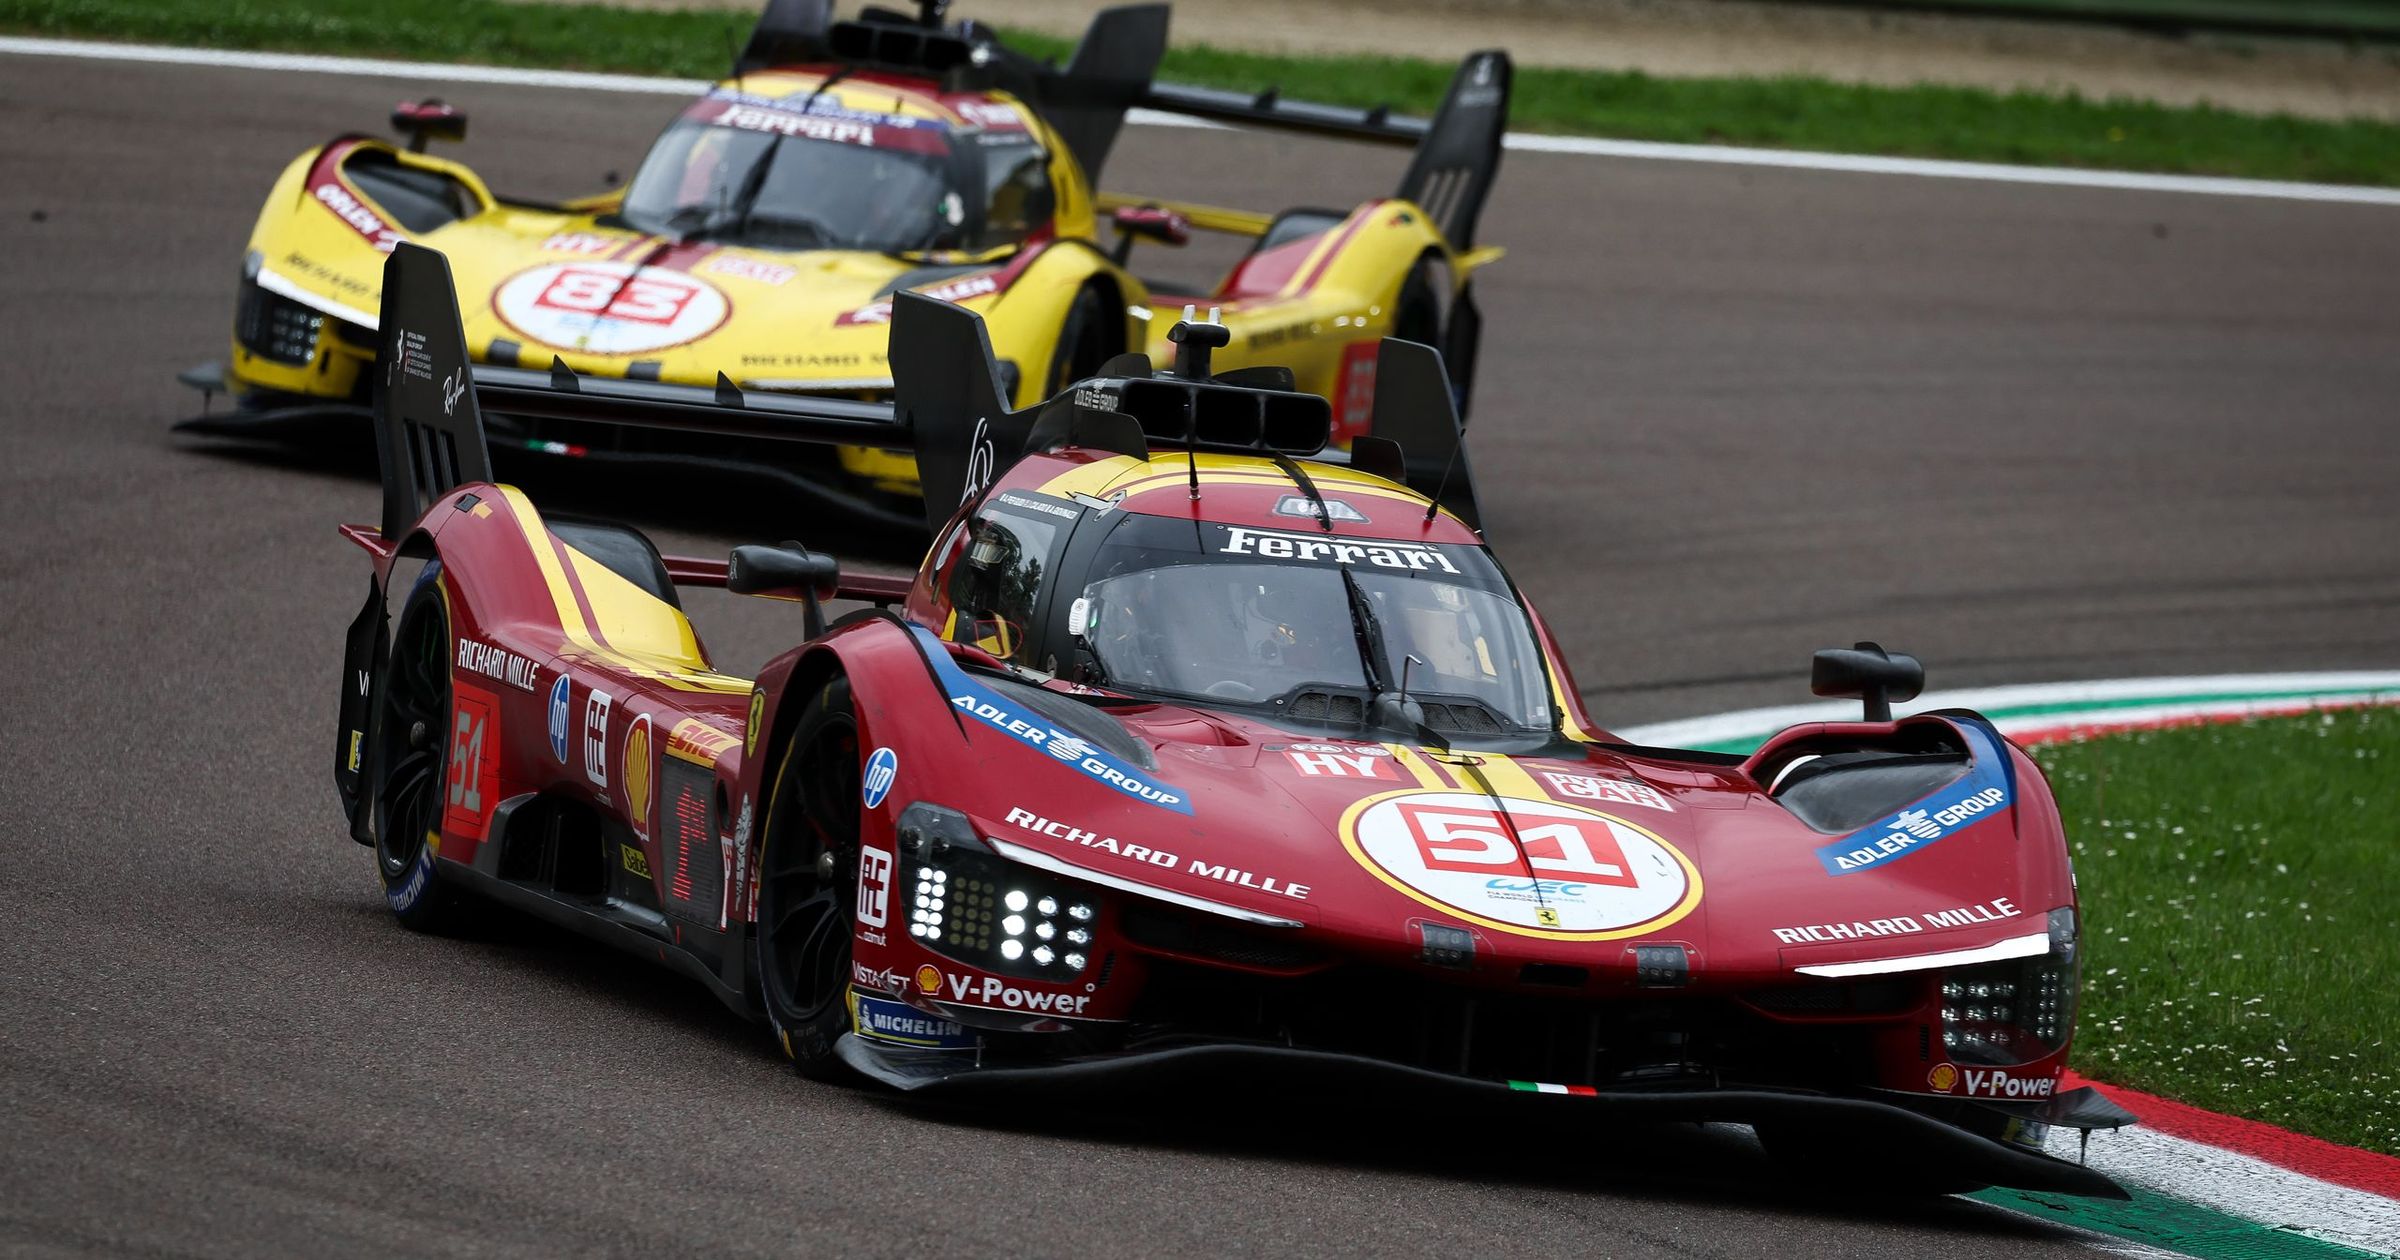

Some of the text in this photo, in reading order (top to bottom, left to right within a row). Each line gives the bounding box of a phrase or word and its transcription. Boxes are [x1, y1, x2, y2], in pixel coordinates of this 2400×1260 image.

[714, 103, 875, 146] Ferrari
[316, 184, 382, 235] ORLEN
[545, 269, 689, 320] 83
[1074, 388, 1119, 412] ADLER GROUP
[1219, 527, 1461, 574] Ferrari
[458, 637, 540, 691] RICHARD MILLE
[450, 710, 485, 813] 51
[674, 724, 728, 759] DHL
[951, 695, 1180, 805] ADLER GROUP
[1290, 752, 1377, 778] HY
[865, 748, 896, 808] hp
[1550, 774, 1653, 794] HYPER
[1561, 783, 1665, 809] CAR
[1414, 811, 1623, 878] 51
[1834, 787, 2004, 870] ADLER GROUP
[1004, 806, 1311, 899] RICHARD MILLE
[1486, 878, 1587, 896] WEC
[1772, 897, 2022, 944] RICHARD MILLE
[947, 973, 1090, 1014] V-Power
[873, 1013, 963, 1036] MICHELIN
[1964, 1069, 2056, 1097] V-Power
